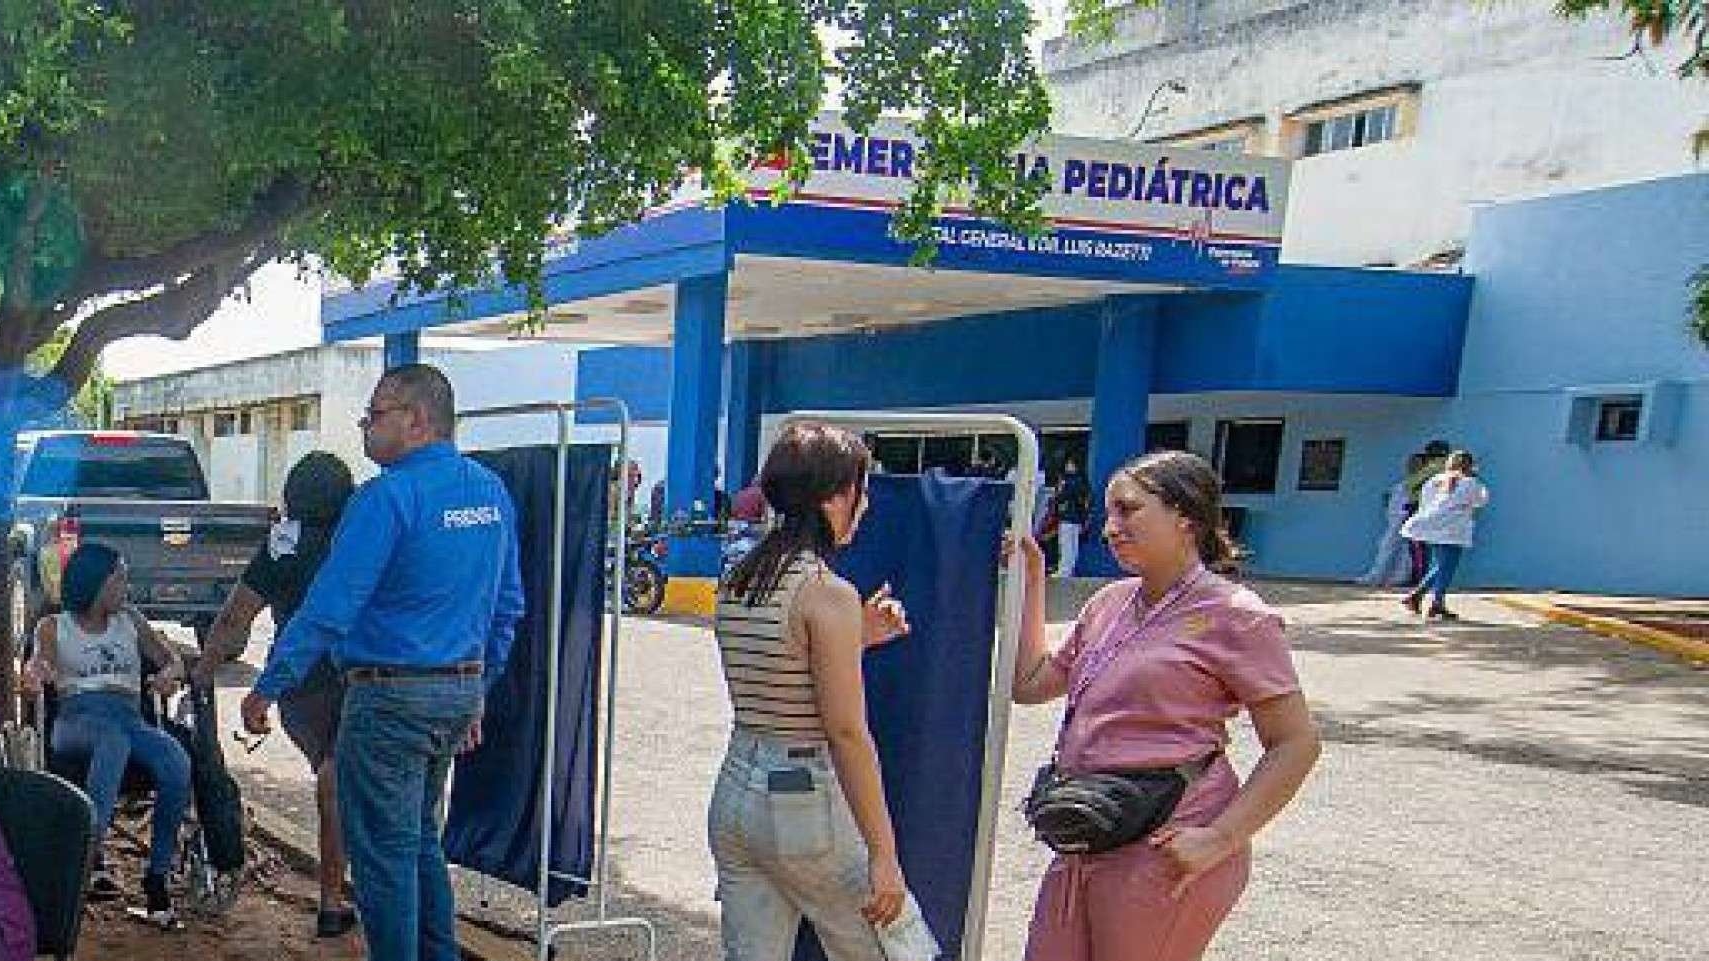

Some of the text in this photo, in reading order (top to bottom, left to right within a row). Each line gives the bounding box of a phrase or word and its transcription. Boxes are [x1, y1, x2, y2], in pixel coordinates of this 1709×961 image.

[810, 131, 1270, 214] EMERIA PEDIÁTRICA
[960, 229, 1026, 251] GENERAL
[1064, 239, 1092, 257] LUIS
